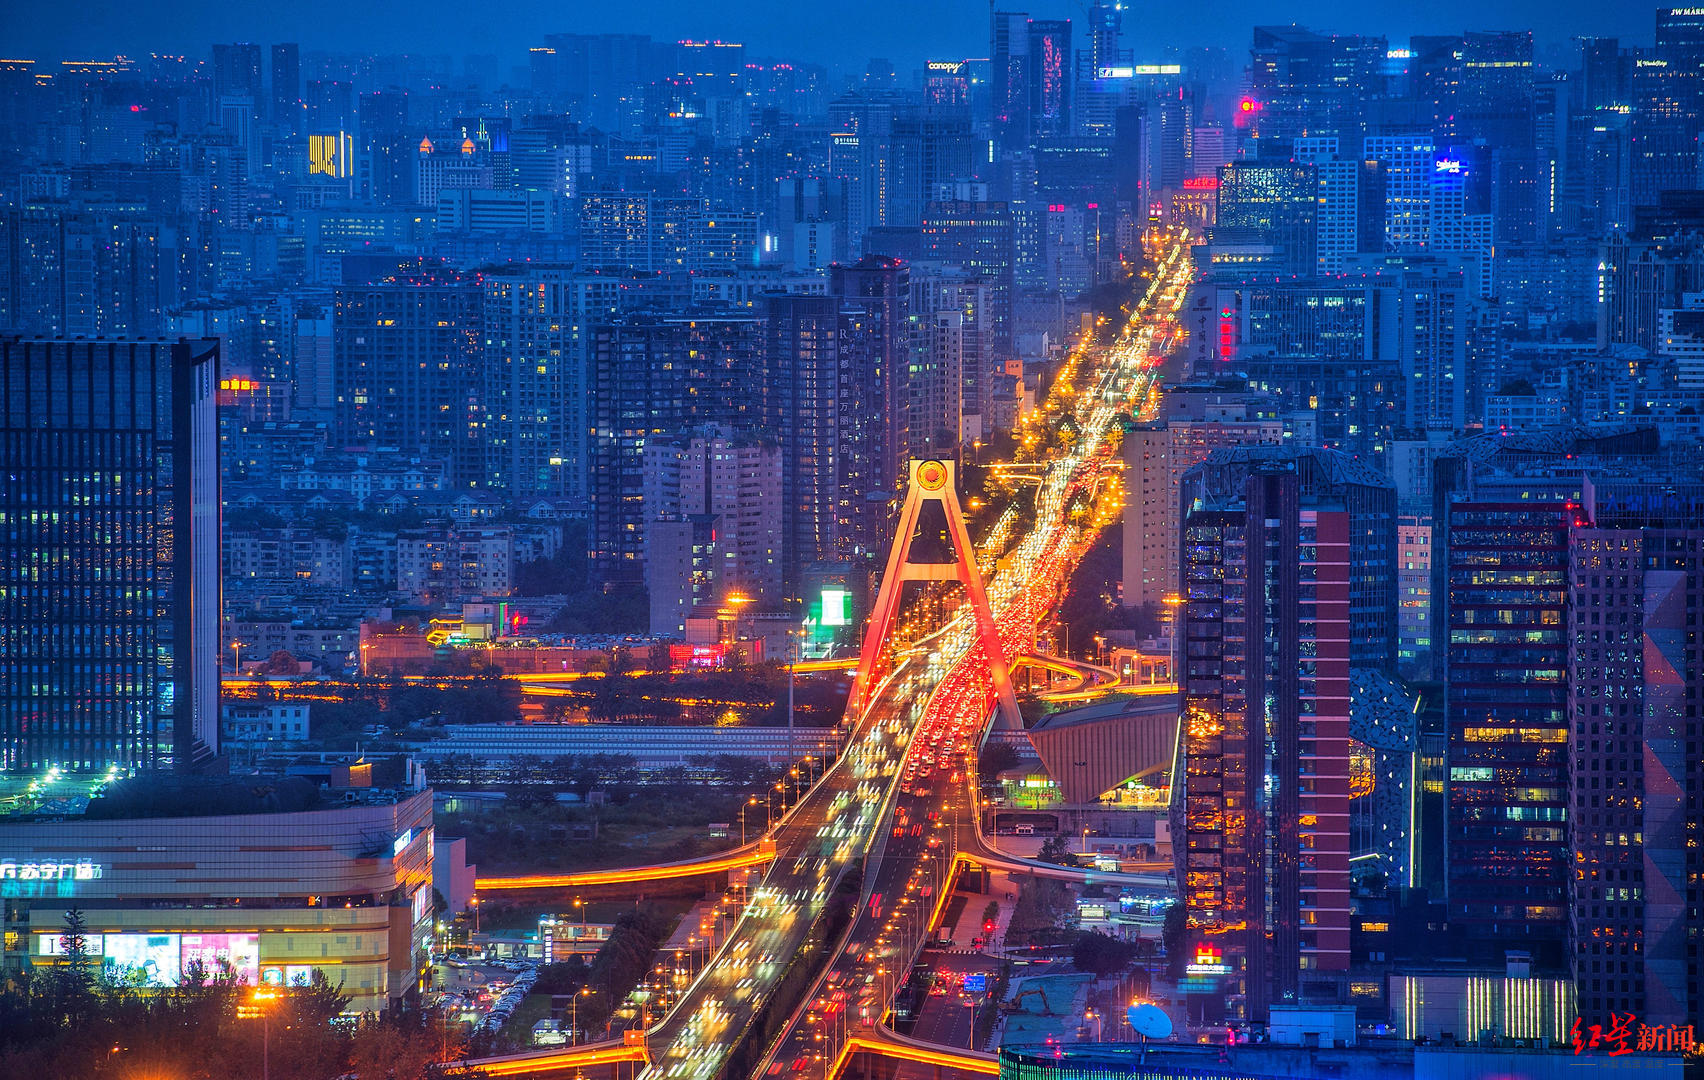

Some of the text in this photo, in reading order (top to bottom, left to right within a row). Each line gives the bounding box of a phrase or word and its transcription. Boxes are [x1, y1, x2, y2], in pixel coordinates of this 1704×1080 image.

[928, 62, 963, 74] canopy
[19, 863, 93, 879] 苏宁广场
